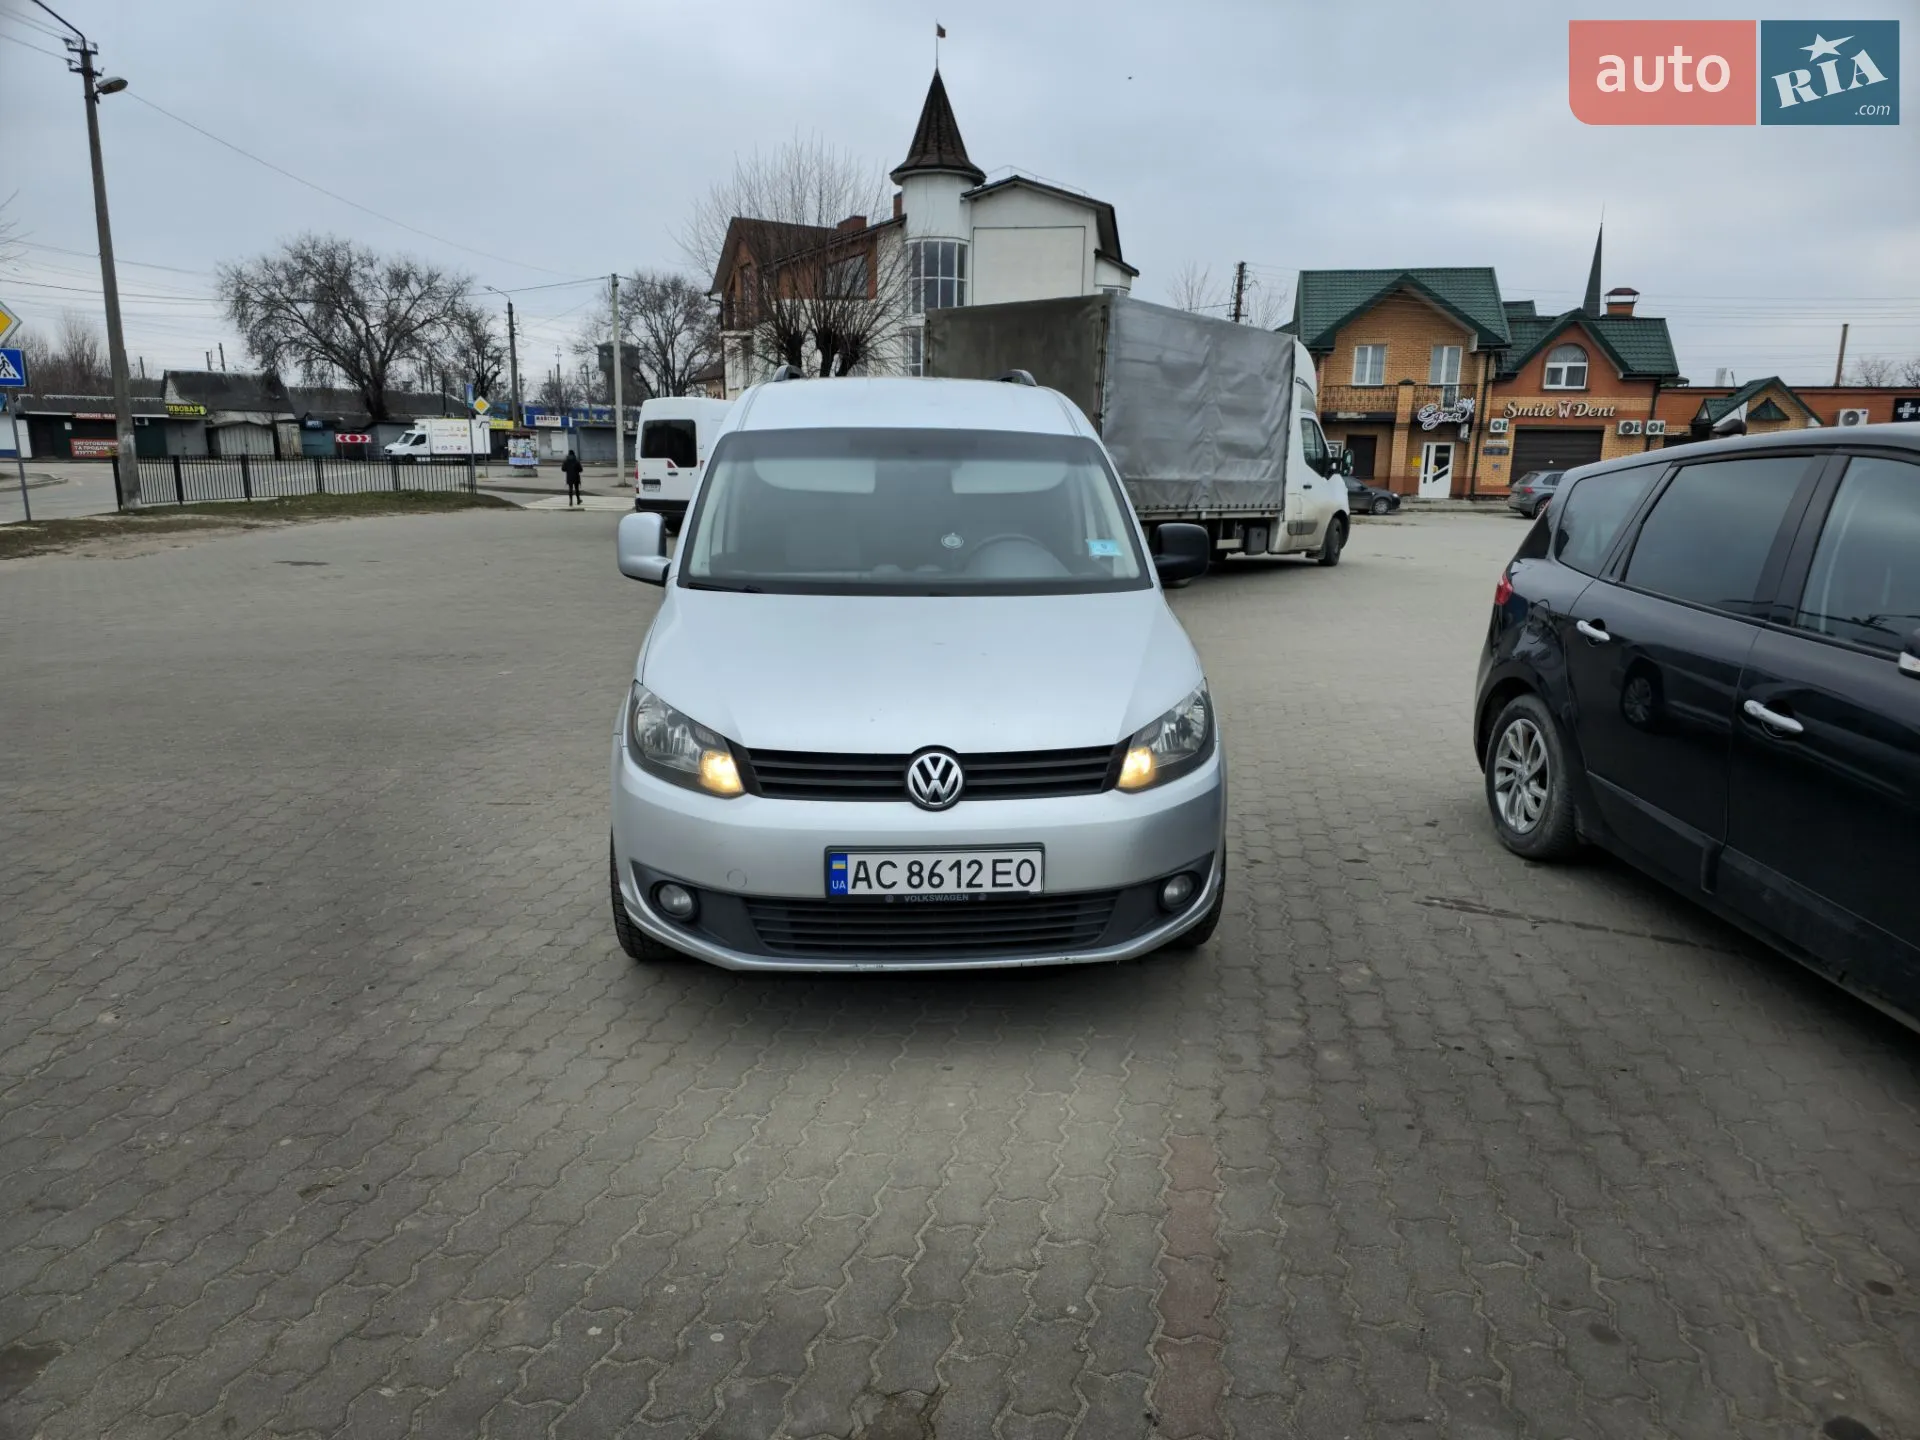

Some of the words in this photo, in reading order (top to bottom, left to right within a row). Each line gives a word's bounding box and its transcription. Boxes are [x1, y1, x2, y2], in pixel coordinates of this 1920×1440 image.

[1504, 401, 1555, 419] Smile
[1573, 401, 1616, 418] Dent
[906, 860, 984, 889] 8612
[832, 880, 846, 890] UA
[904, 894, 970, 902] VOLKSWAGEN
